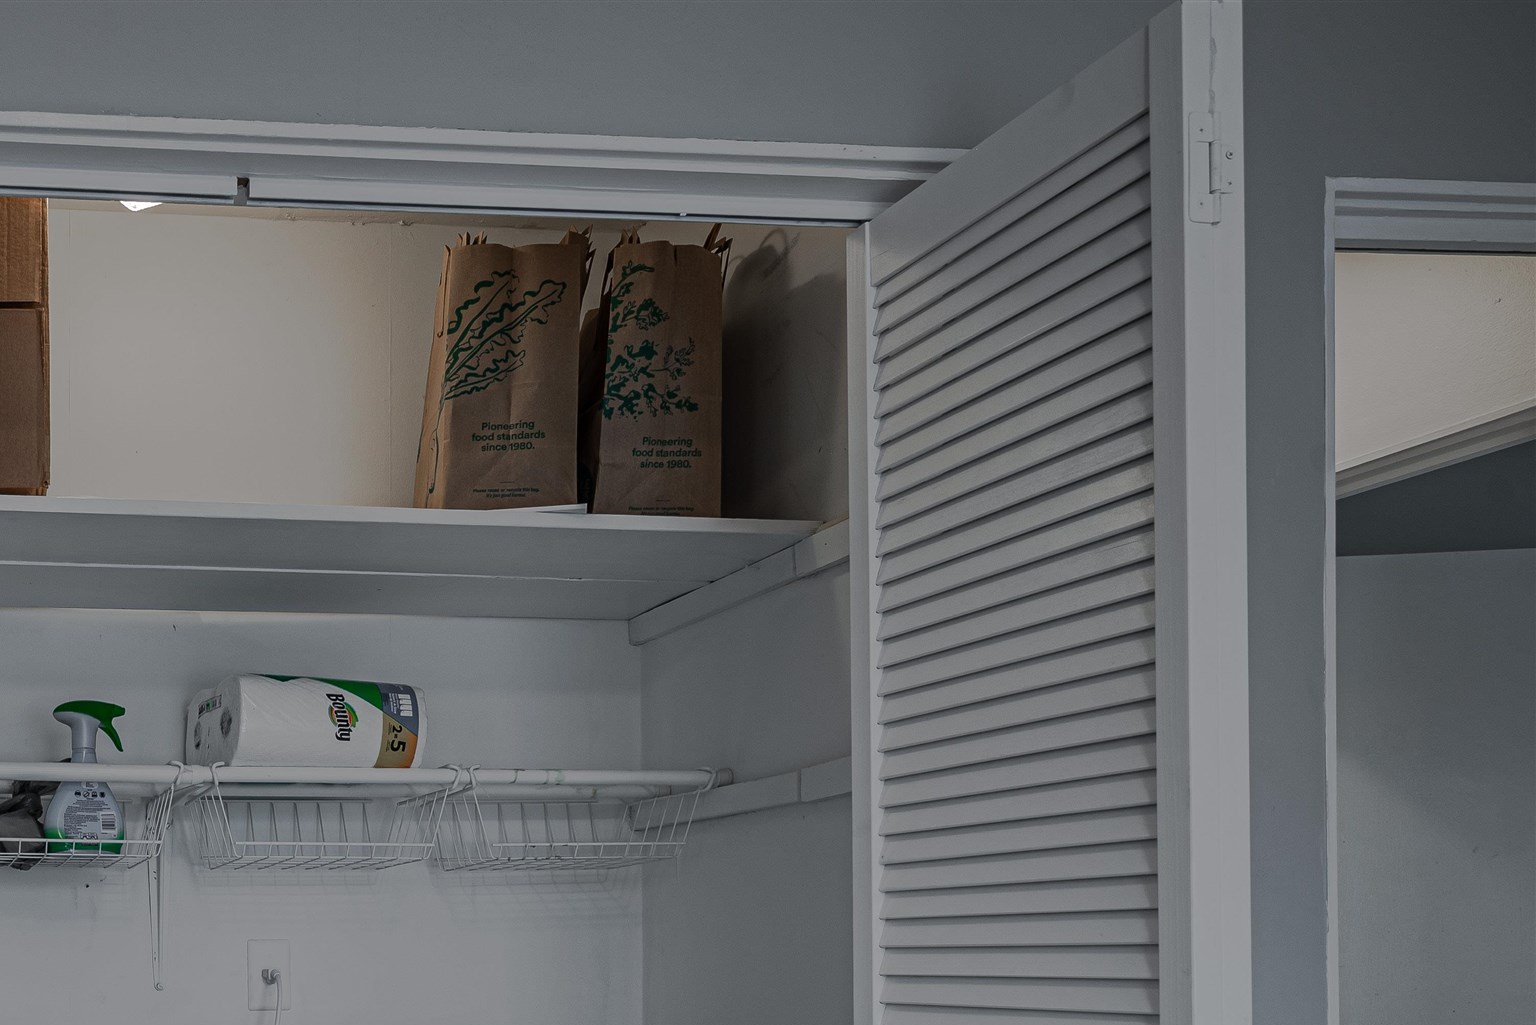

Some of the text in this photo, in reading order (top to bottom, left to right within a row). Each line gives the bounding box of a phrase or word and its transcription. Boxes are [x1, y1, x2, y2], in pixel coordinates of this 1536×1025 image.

[481, 420, 535, 431] Pioneering
[471, 430, 546, 442] food standards
[642, 436, 693, 447] Pioneering
[481, 441, 535, 452] since 1980.
[632, 448, 702, 458] food standards
[640, 459, 692, 469] since 1980.
[325, 693, 353, 742] Bounty
